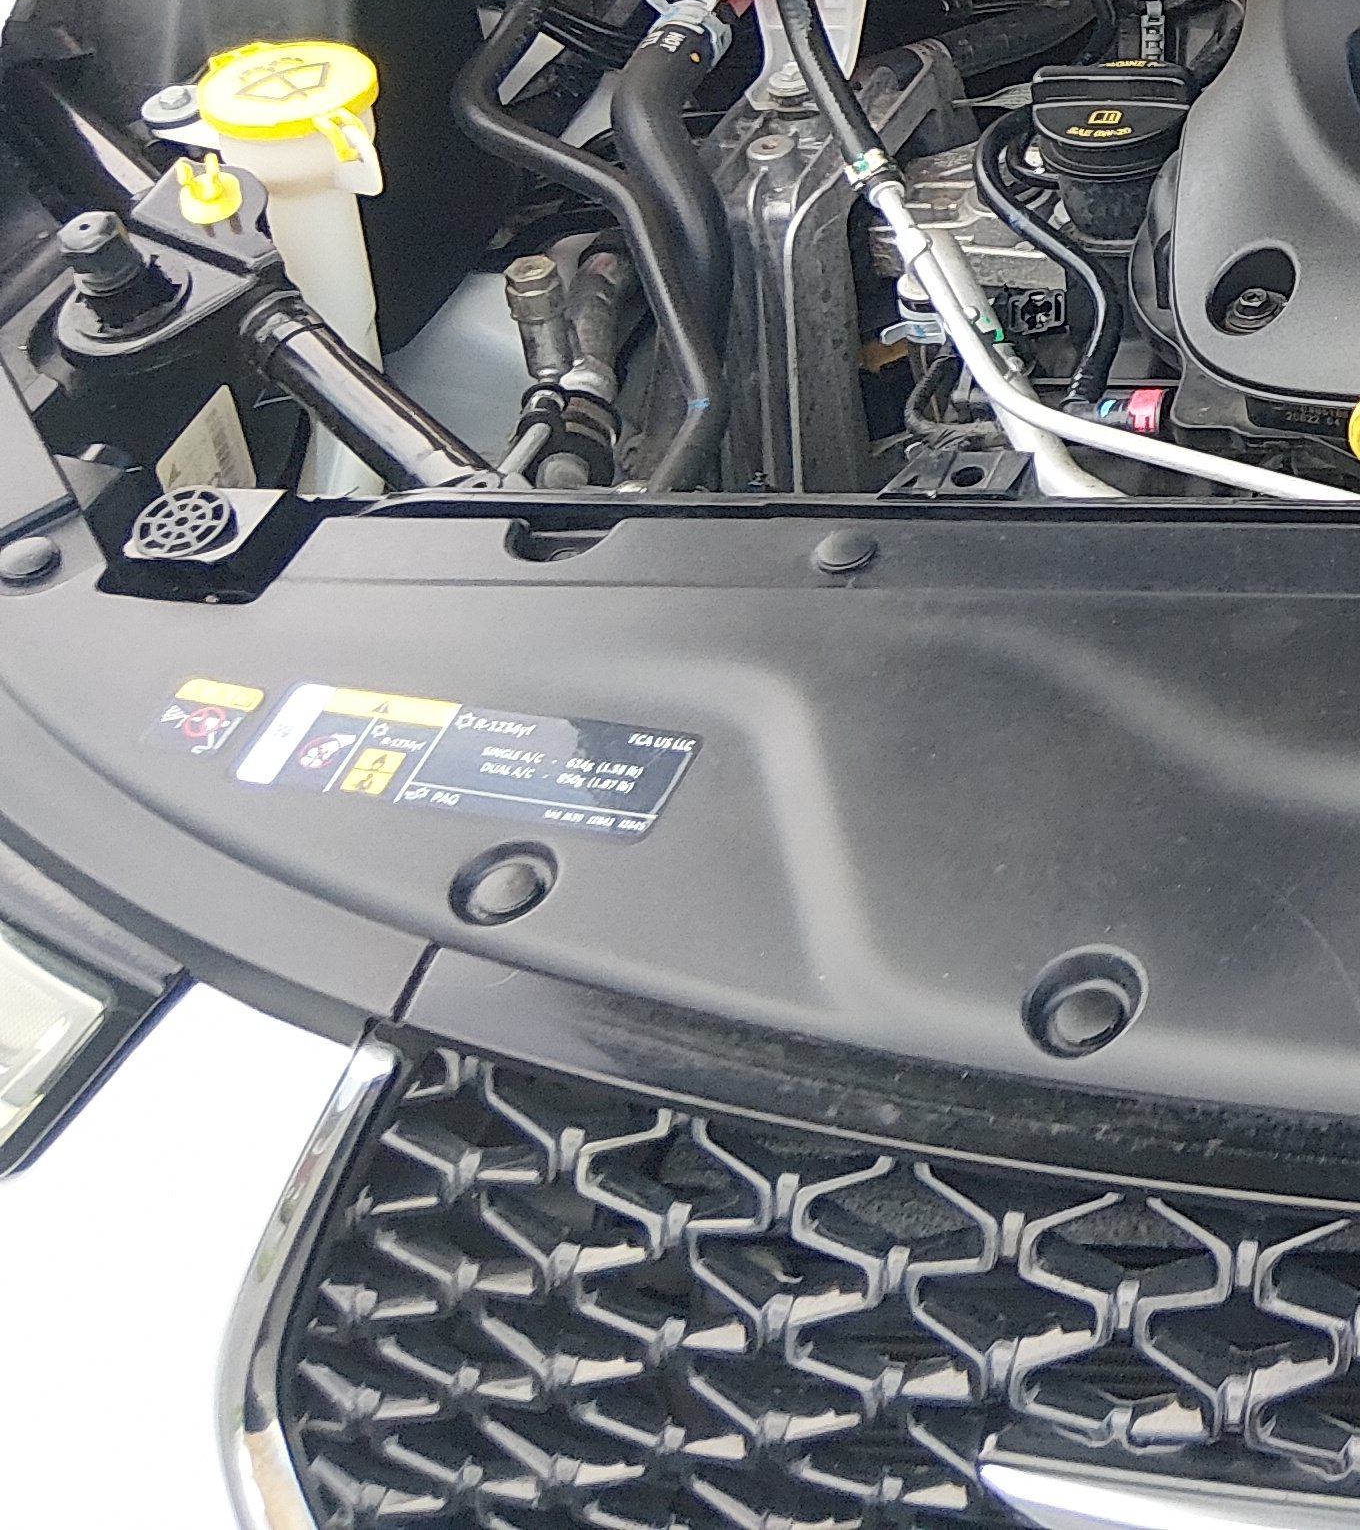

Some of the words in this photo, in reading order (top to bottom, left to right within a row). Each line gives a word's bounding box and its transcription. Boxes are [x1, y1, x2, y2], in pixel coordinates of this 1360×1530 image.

[627, 733, 654, 747] FCA
[654, 736, 673, 749] US
[671, 738, 697, 752] LLC
